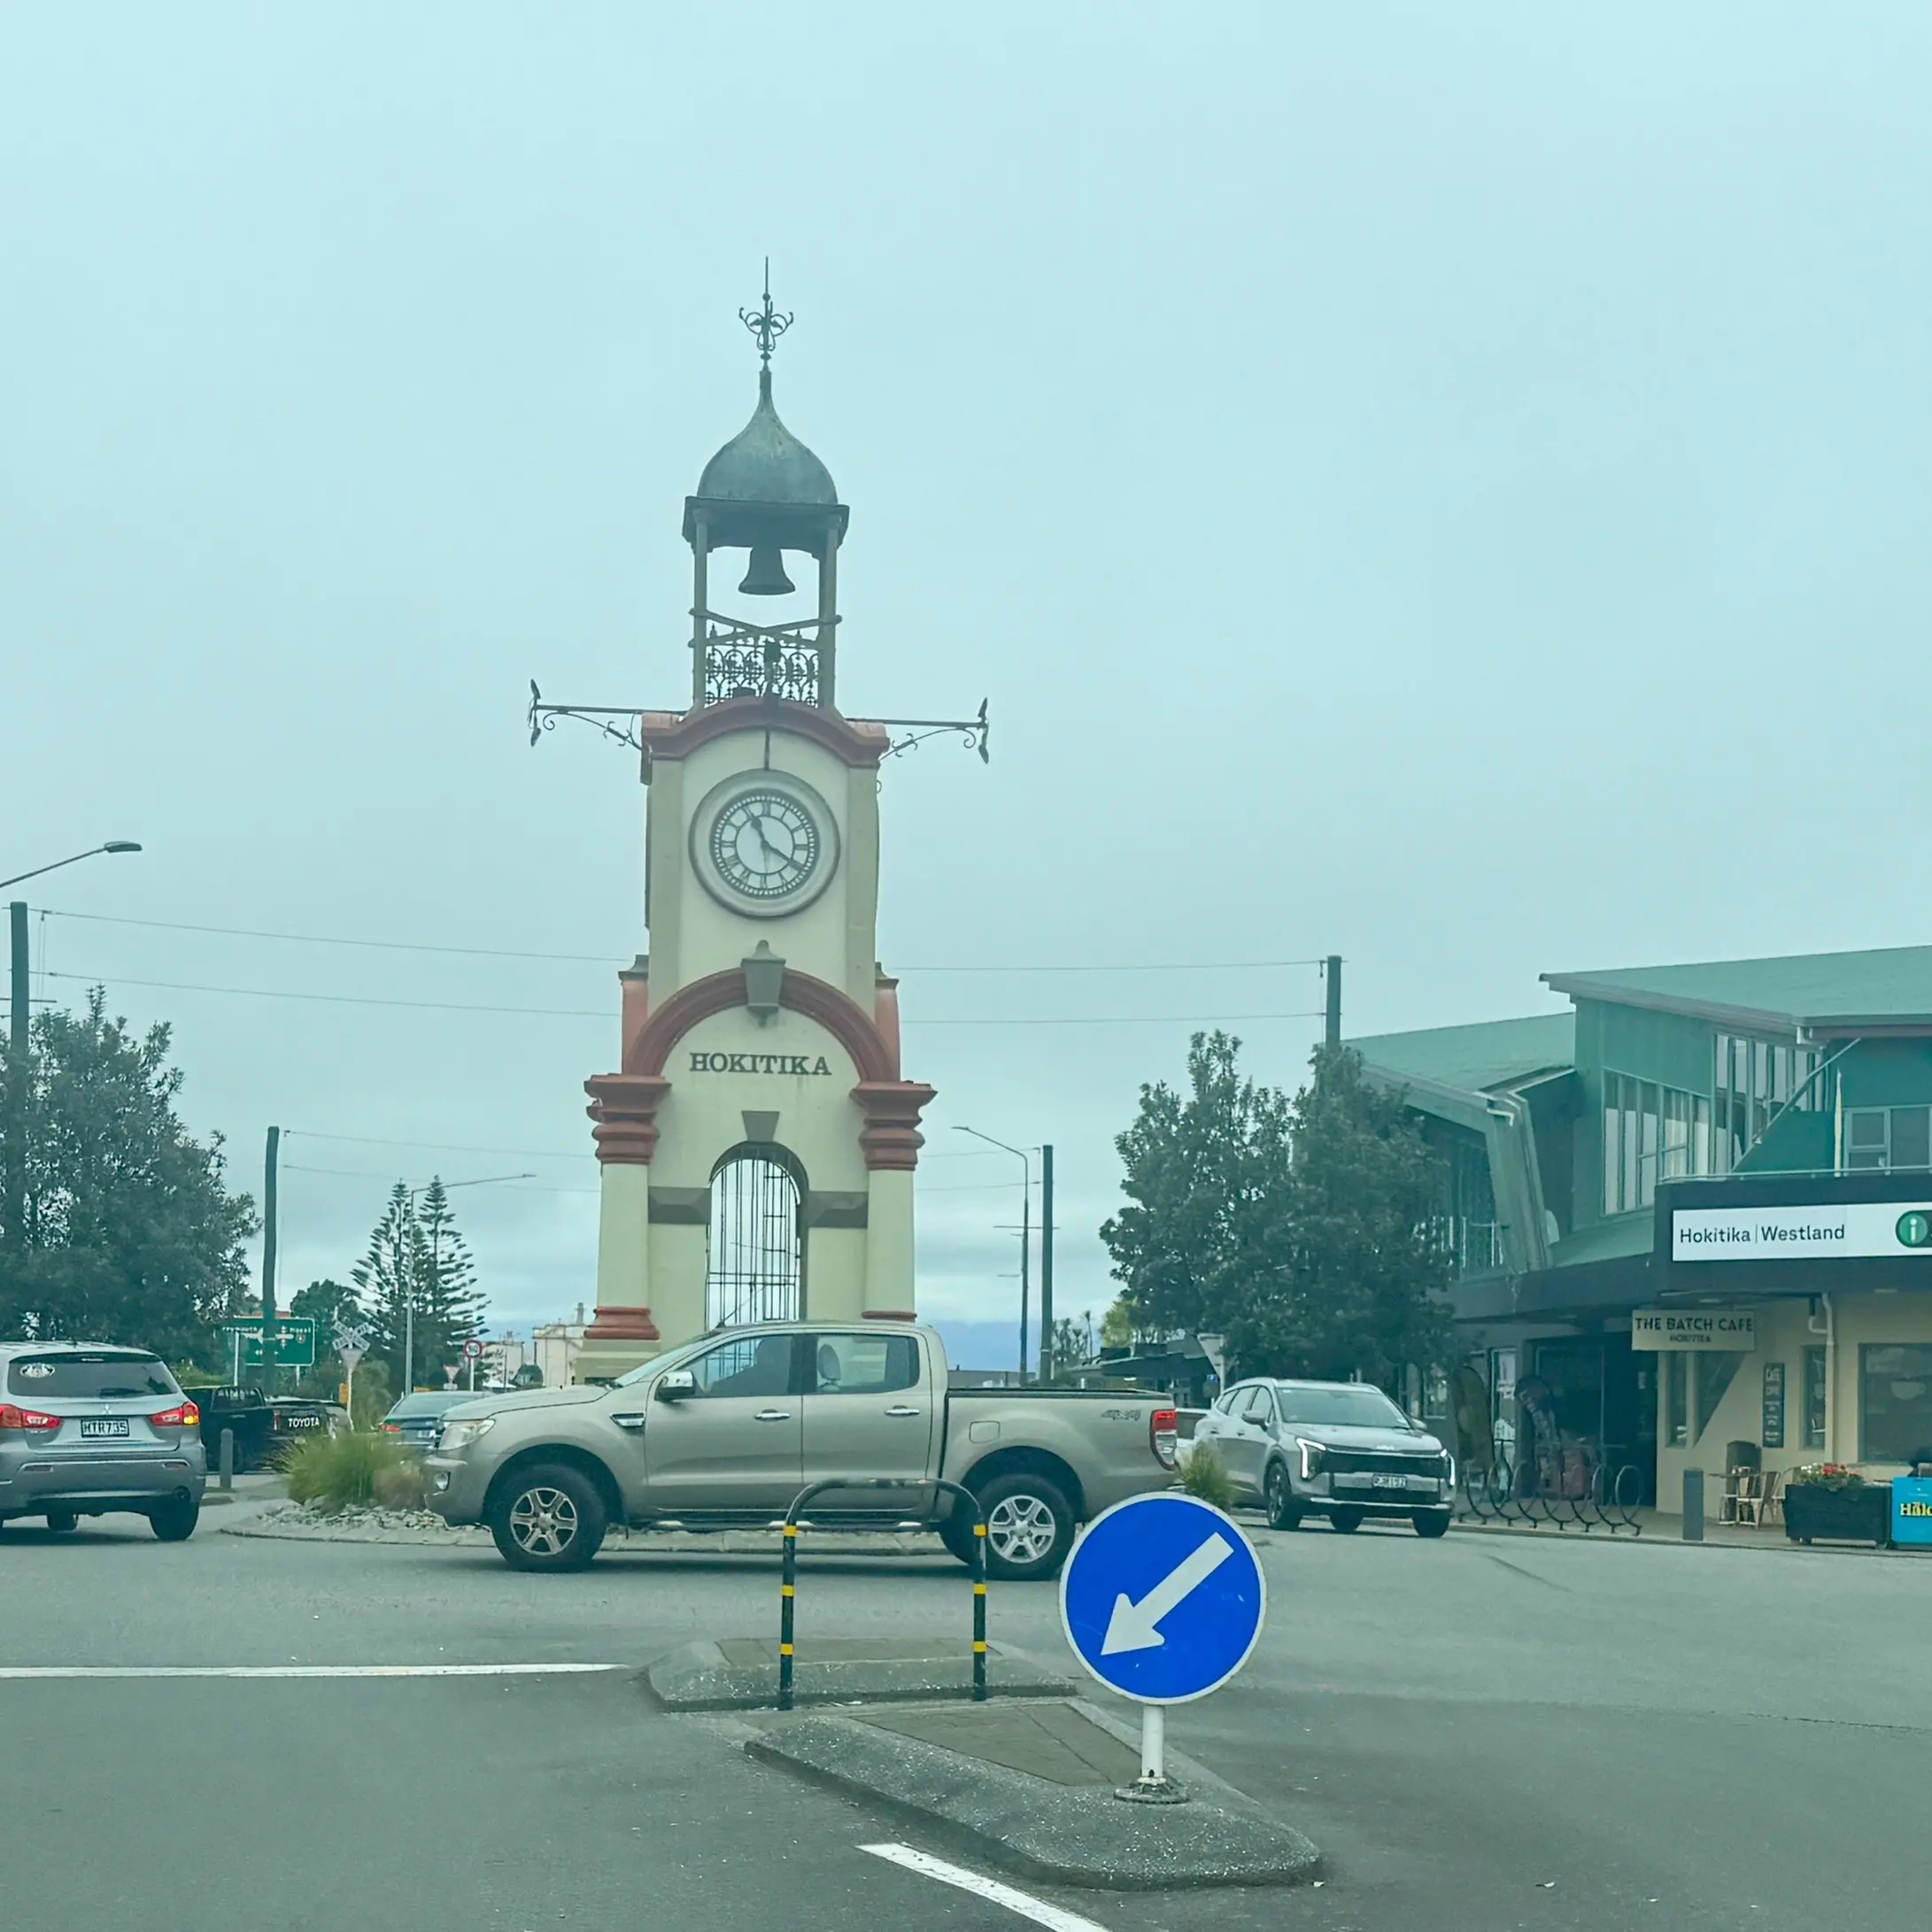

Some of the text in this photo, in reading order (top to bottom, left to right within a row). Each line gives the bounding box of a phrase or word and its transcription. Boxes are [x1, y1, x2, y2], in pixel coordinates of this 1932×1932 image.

[689, 1052, 832, 1076] HOKITIKA
[1680, 1224, 1845, 1244] Hokitika Westland
[1634, 1318, 1662, 1331] THE
[1666, 1318, 1713, 1332] BATCH
[288, 1417, 320, 1427] TOYOTA
